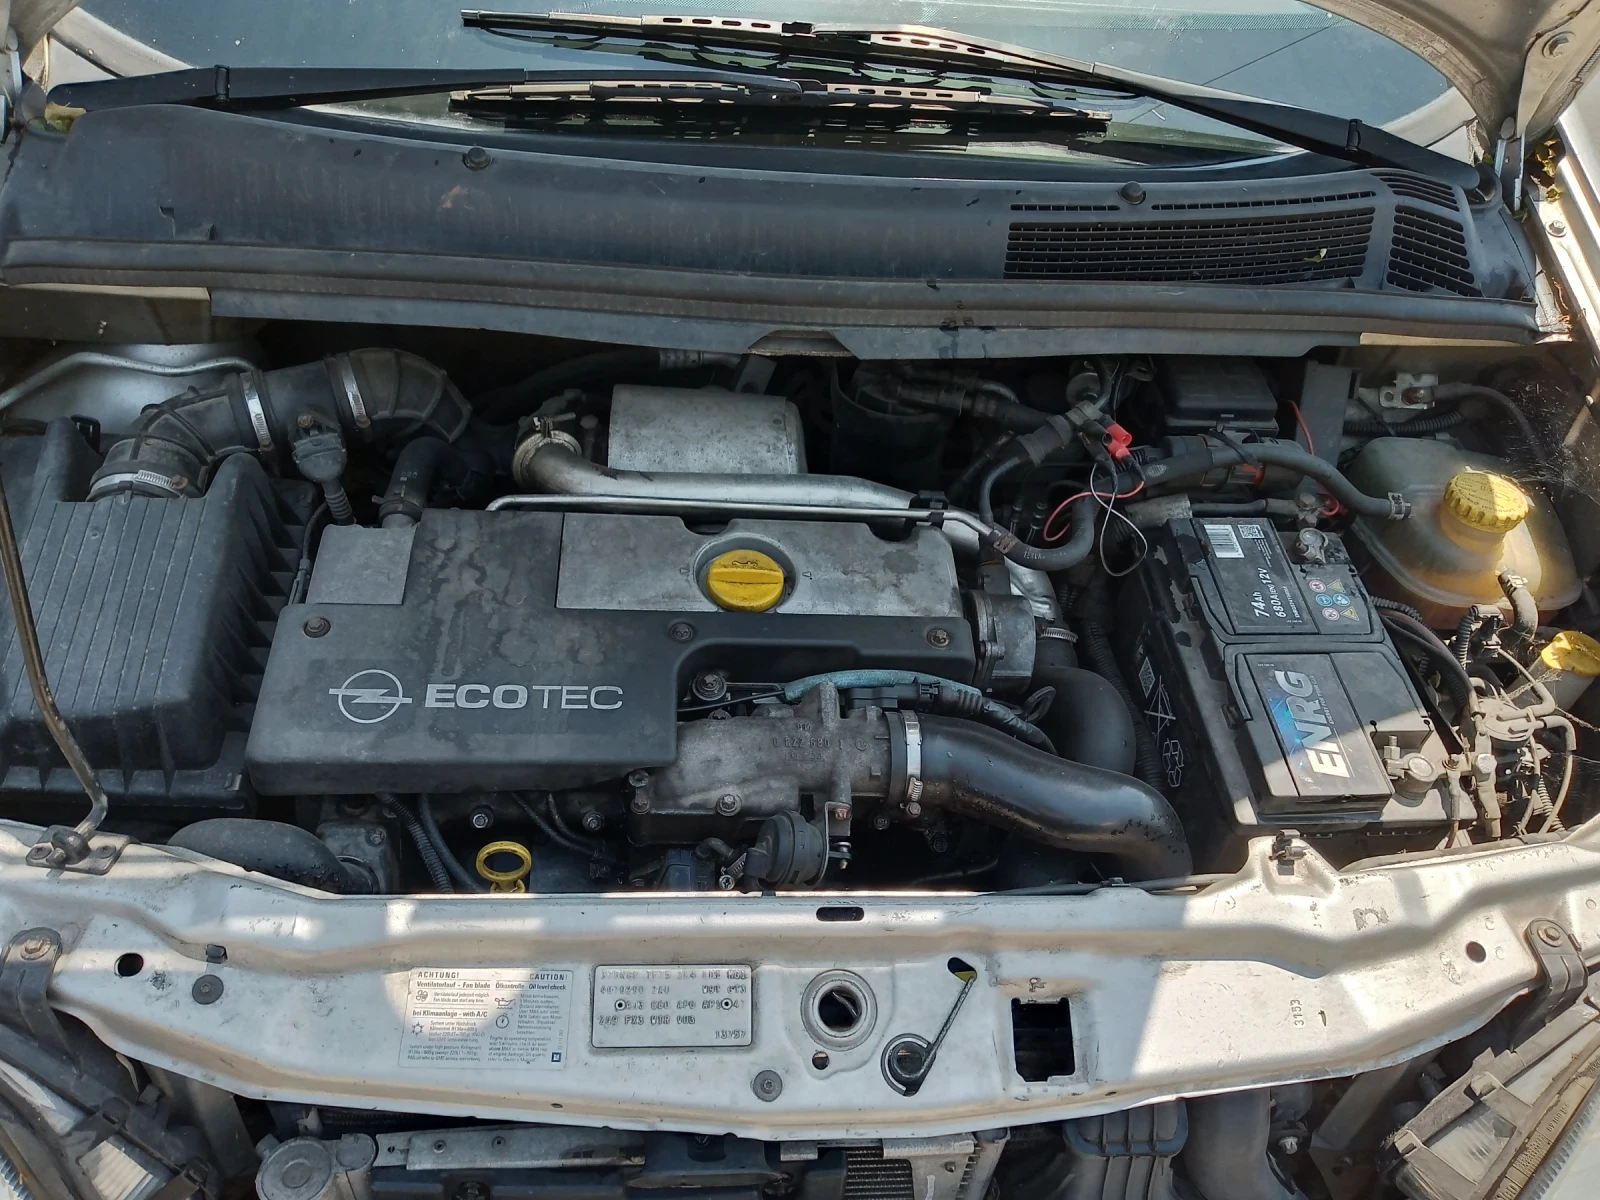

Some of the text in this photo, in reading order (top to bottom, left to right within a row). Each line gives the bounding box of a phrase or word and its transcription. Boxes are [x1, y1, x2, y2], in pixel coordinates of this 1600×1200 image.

[1258, 568, 1272, 584] 12V
[1251, 591, 1270, 617] 74Ah
[424, 684, 624, 710] ECOTEC
[1274, 670, 1350, 778] ENRG
[1290, 999, 1304, 1026] 3153
